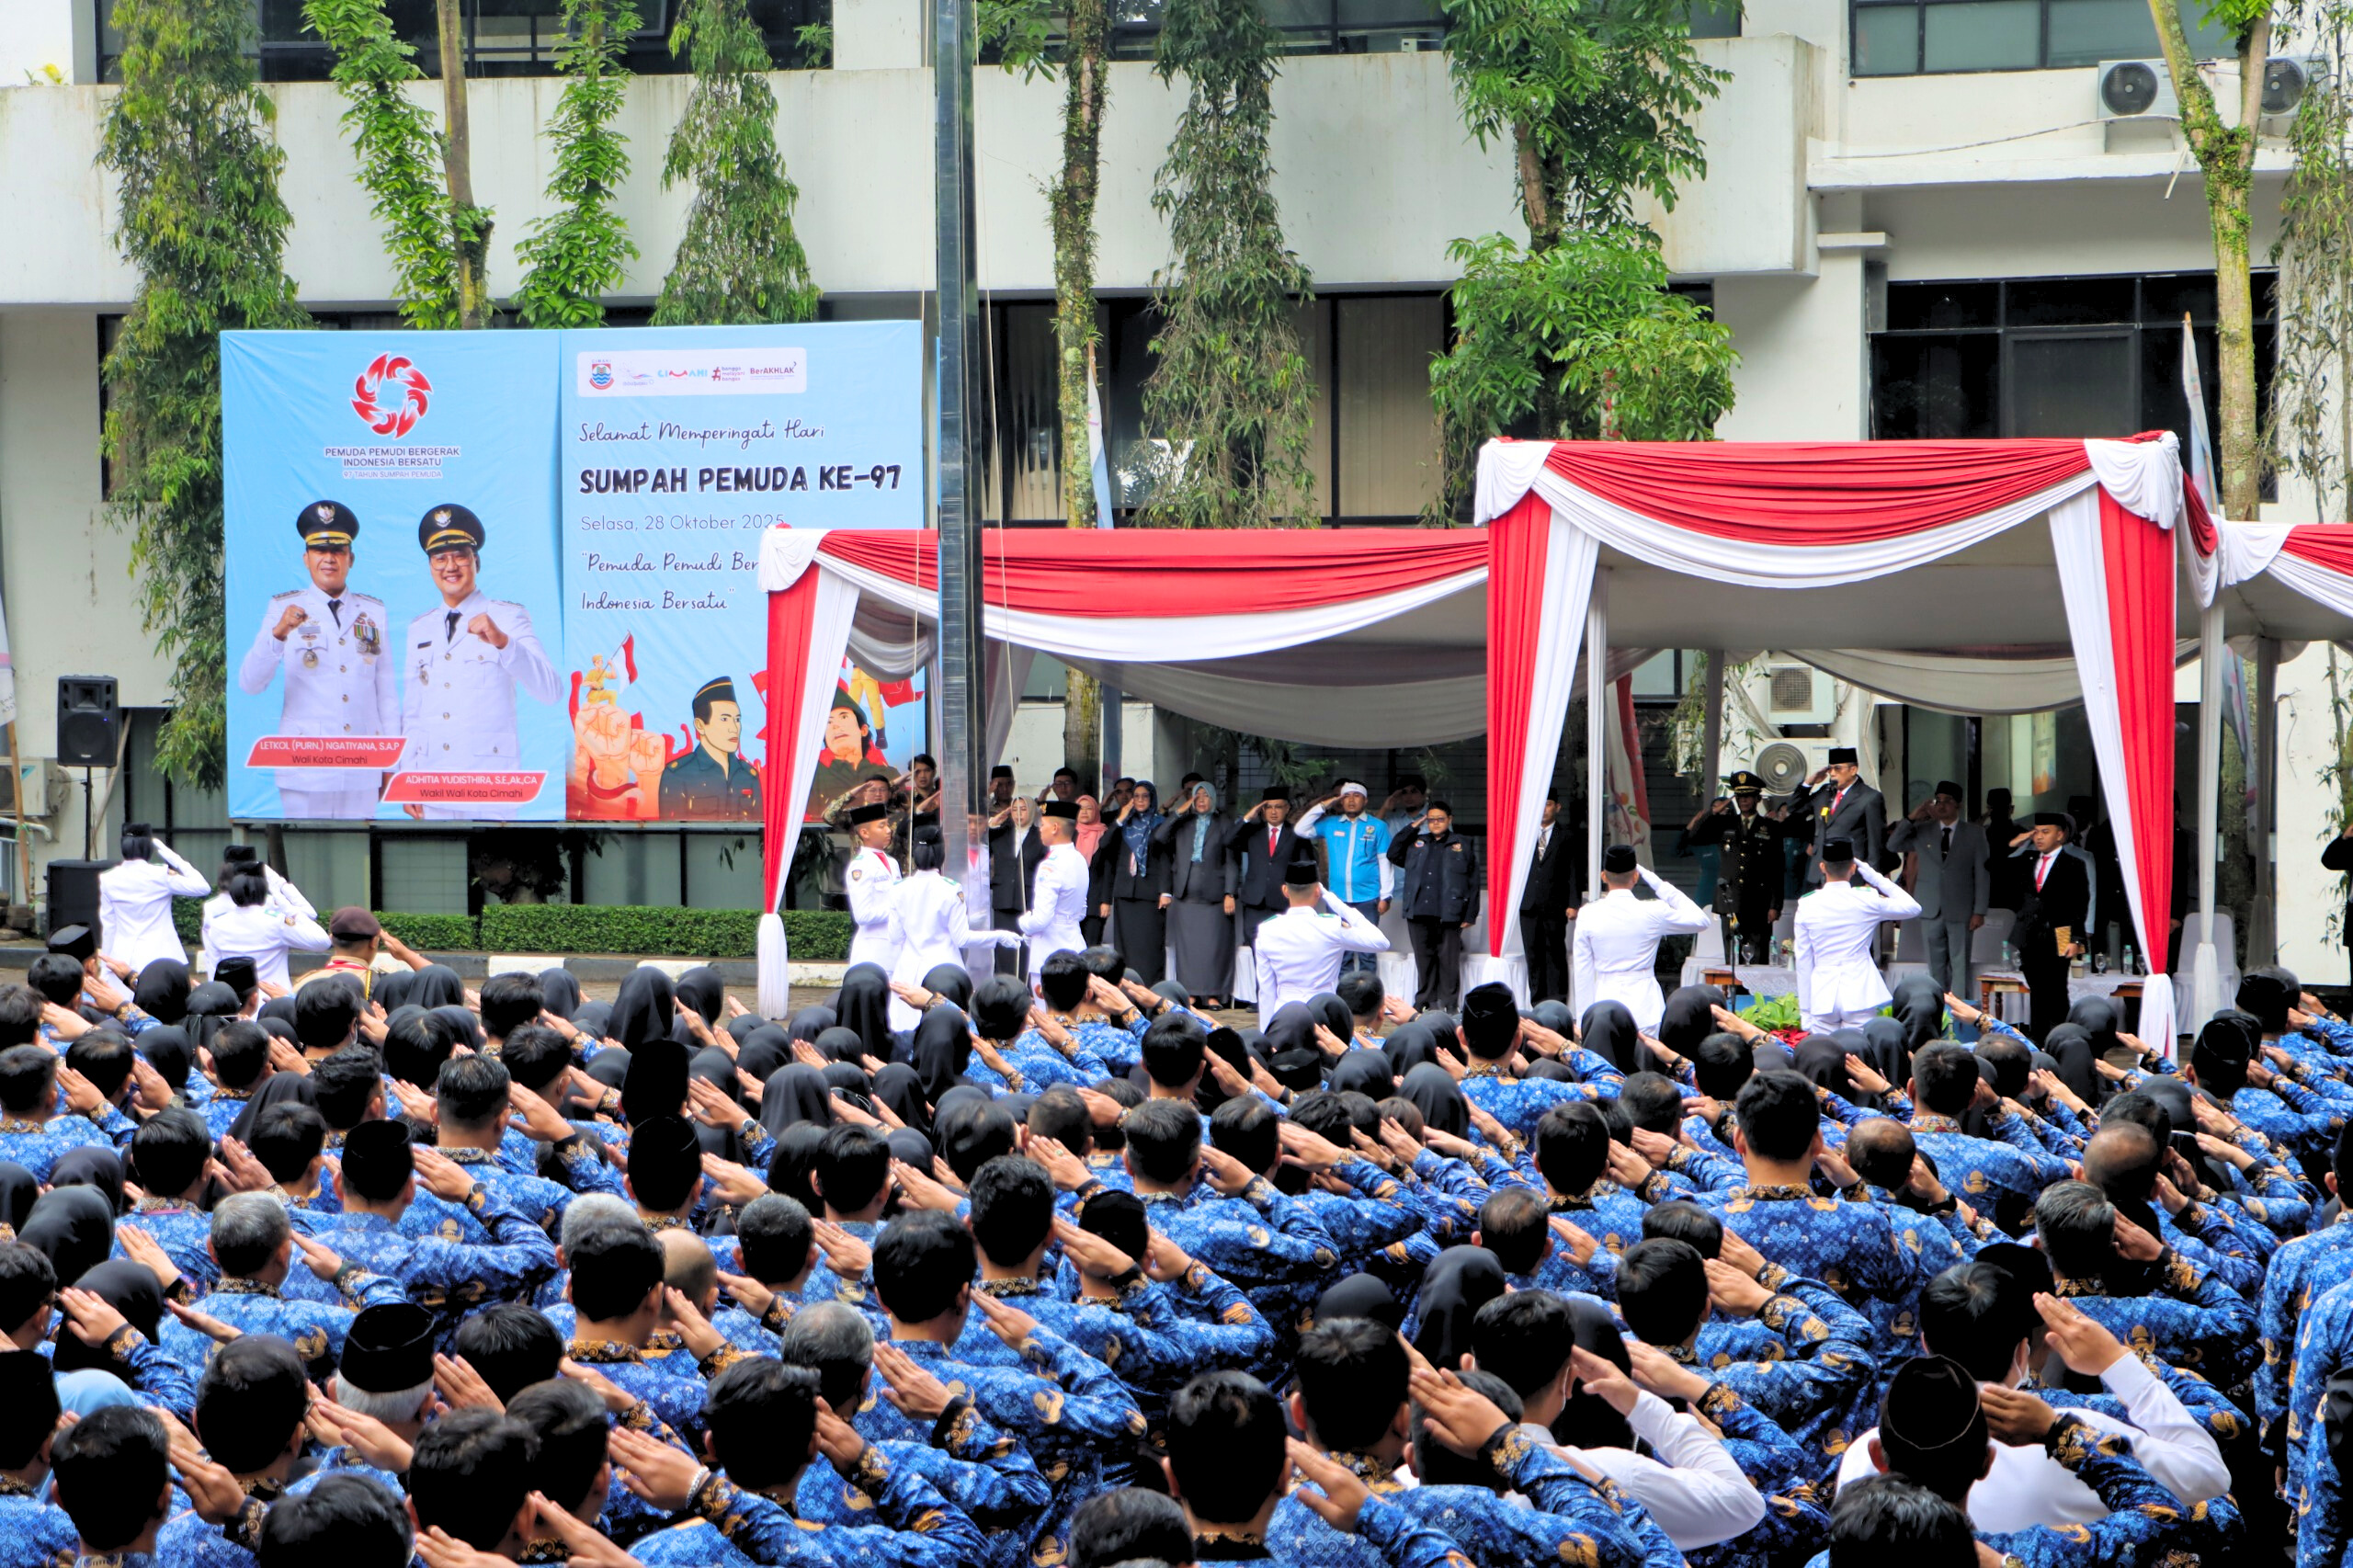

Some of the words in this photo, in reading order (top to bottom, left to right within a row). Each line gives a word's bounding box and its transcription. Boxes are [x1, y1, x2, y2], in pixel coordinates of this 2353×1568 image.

[750, 366, 796, 374] BerAKHLAK
[579, 421, 653, 442] Selamat
[658, 419, 776, 449] Memperingati
[784, 418, 824, 439] Hari
[324, 448, 367, 457] PEMUDA
[369, 448, 405, 456] PEMUDI
[408, 448, 460, 456] BERGERAK
[344, 458, 395, 467] INDONESIA
[398, 458, 441, 466] BERSATU
[579, 467, 688, 494] SUMPAH
[699, 466, 809, 494] PEMUDA
[819, 464, 903, 492] KE-97
[581, 515, 639, 533] Selasa,
[644, 515, 665, 530] 28
[670, 514, 736, 530] Oktober
[741, 514, 785, 530] 2025
[663, 551, 722, 572] Pemudi
[582, 590, 655, 610] Indonesia
[260, 741, 290, 750] LETKOL
[326, 741, 378, 752] NGATIYANA,
[379, 741, 400, 751] S.A.P
[291, 756, 312, 765] Wali
[313, 756, 334, 765] Kota
[335, 756, 369, 765] Cimahi
[405, 775, 440, 784] ADHITIA
[419, 789, 444, 798] Wakil
[446, 789, 466, 798] Wali
[467, 789, 488, 798] Kota
[489, 789, 523, 798] Cimahi
